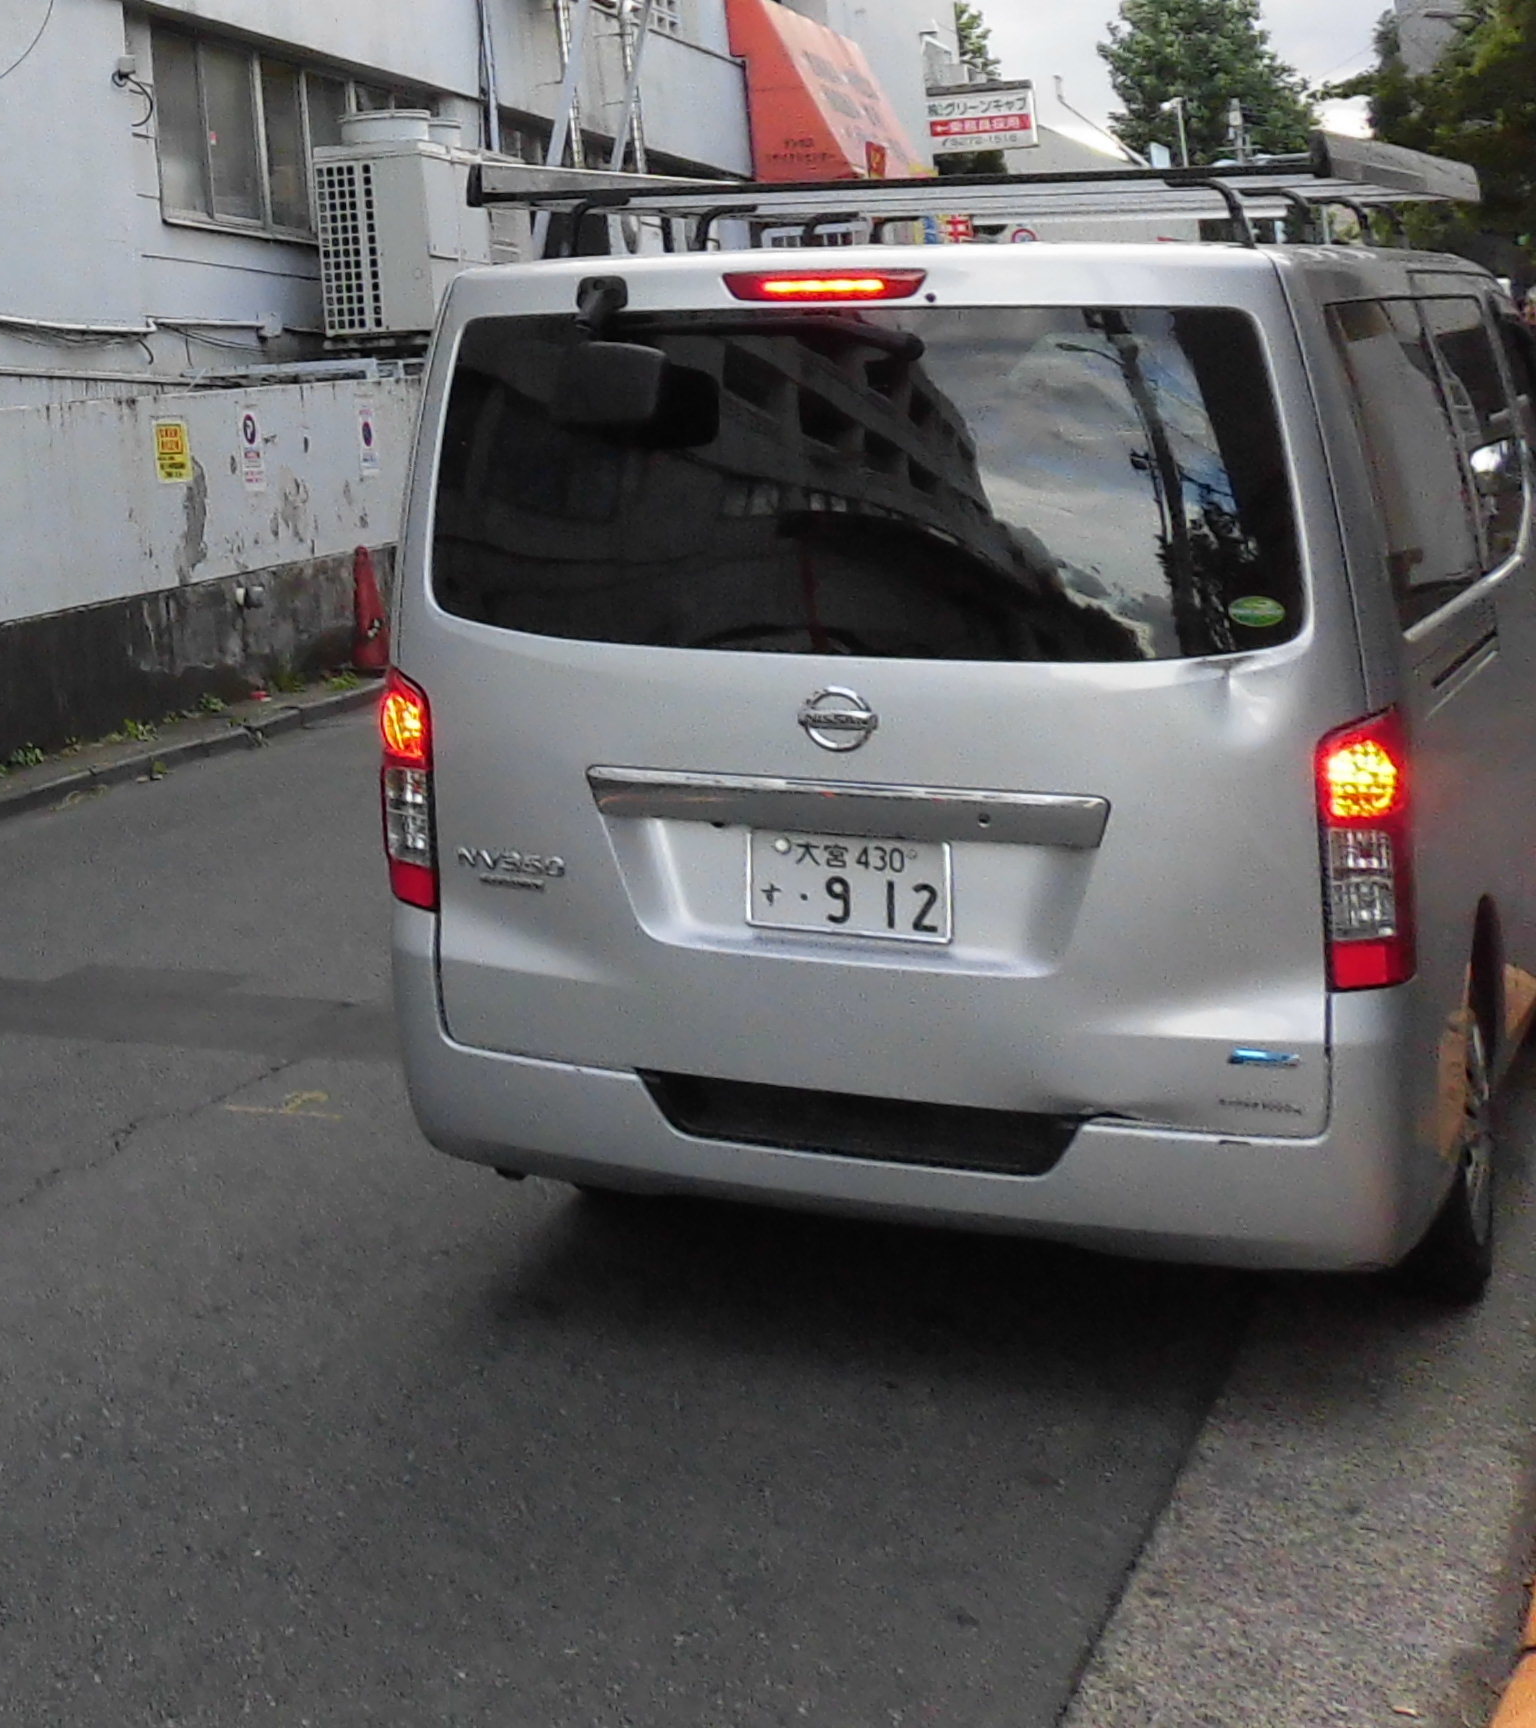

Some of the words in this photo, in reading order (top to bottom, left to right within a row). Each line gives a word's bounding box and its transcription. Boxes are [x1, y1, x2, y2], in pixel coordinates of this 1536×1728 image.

[806, 712, 869, 727] NISSAN
[457, 846, 566, 878] NV350
[795, 842, 849, 869] 大宮
[855, 845, 905, 874] 430
[761, 882, 783, 907] す
